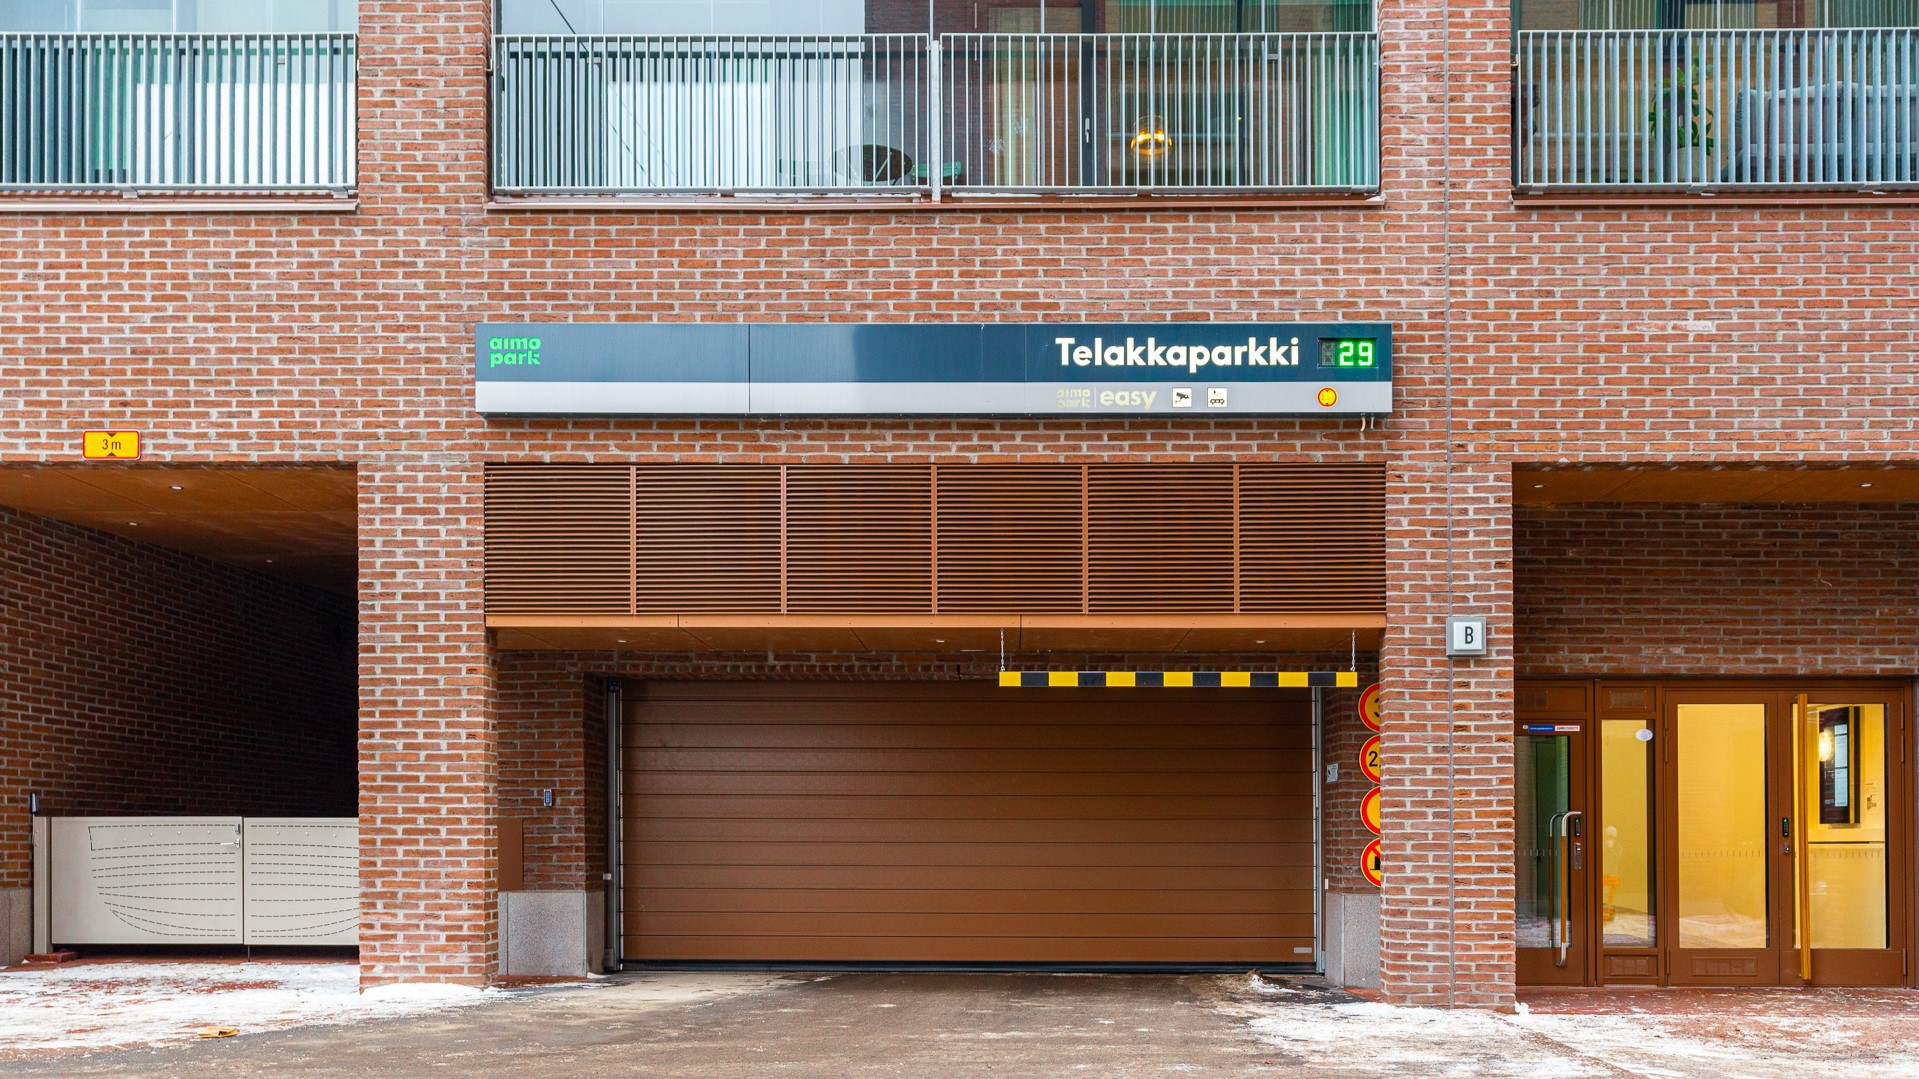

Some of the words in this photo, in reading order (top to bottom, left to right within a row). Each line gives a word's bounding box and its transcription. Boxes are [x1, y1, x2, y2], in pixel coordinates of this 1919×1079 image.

[489, 337, 541, 350] aimo
[489, 350, 541, 368] park
[1055, 337, 1299, 373] Telakkaparkki
[1339, 341, 1373, 366] 29
[1099, 390, 1157, 410] easy
[102, 438, 109, 450] 3
[111, 441, 121, 450] m
[1464, 626, 1474, 644] B
